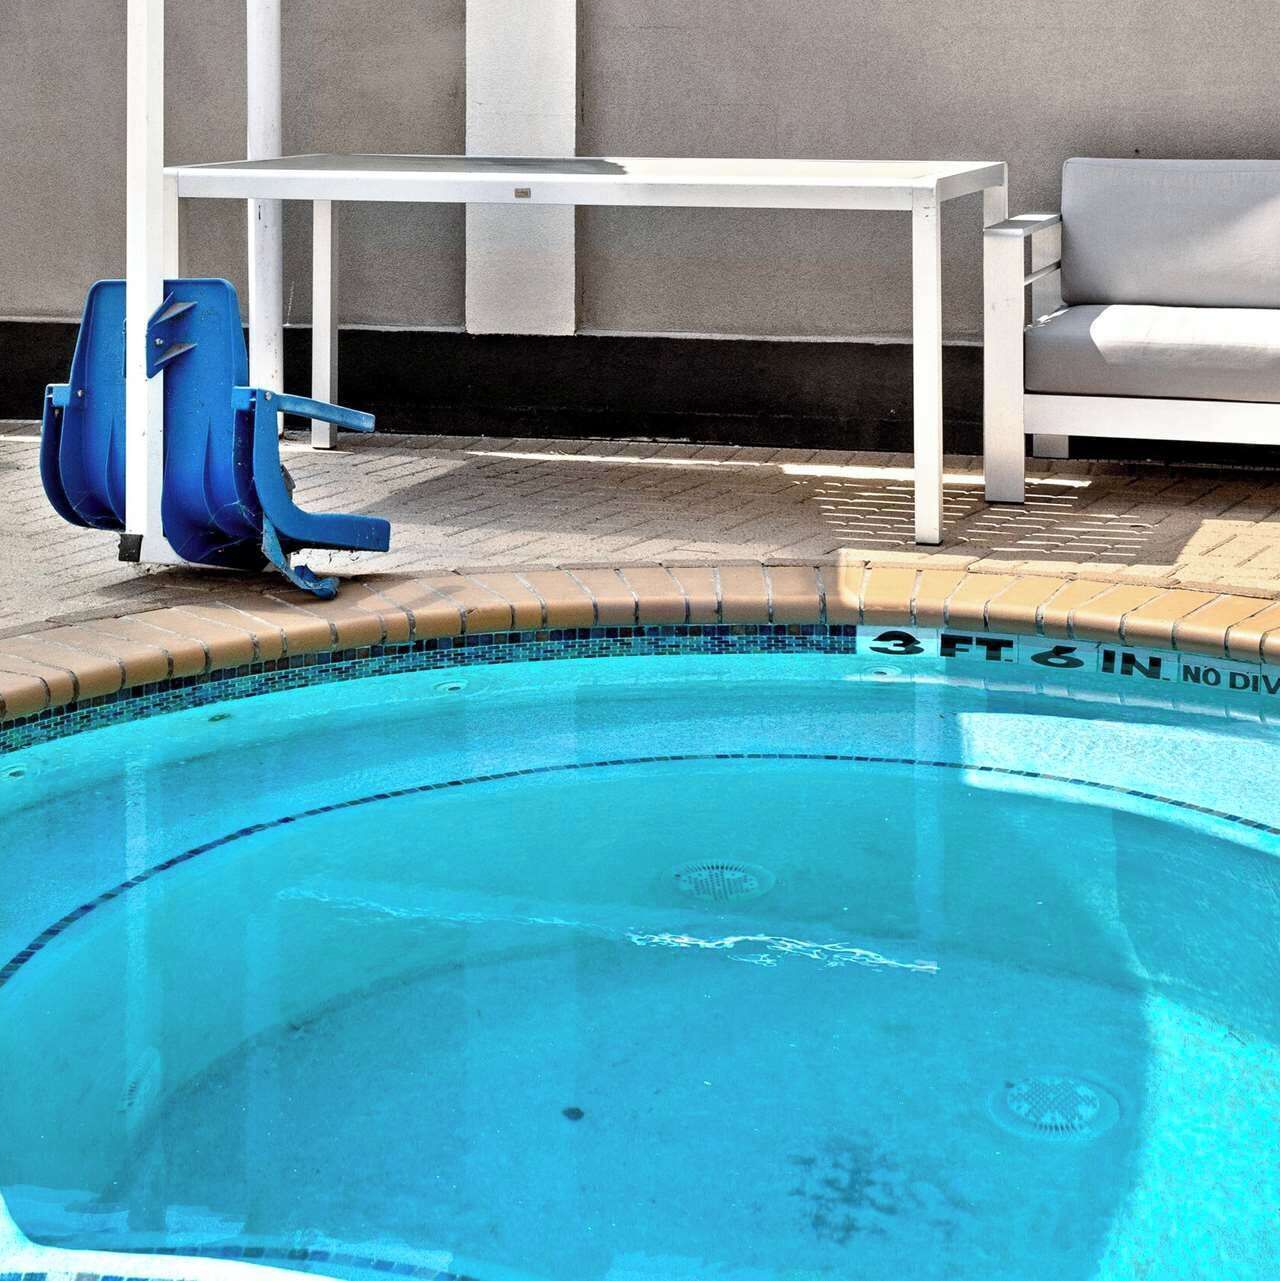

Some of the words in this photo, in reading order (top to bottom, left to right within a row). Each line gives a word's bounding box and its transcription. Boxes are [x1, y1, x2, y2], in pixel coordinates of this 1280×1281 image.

[869, 630, 925, 655] 3
[939, 633, 1014, 662] FT.
[1030, 645, 1084, 669] 6
[1101, 649, 1171, 681] IN.
[1182, 664, 1221, 686] NO
